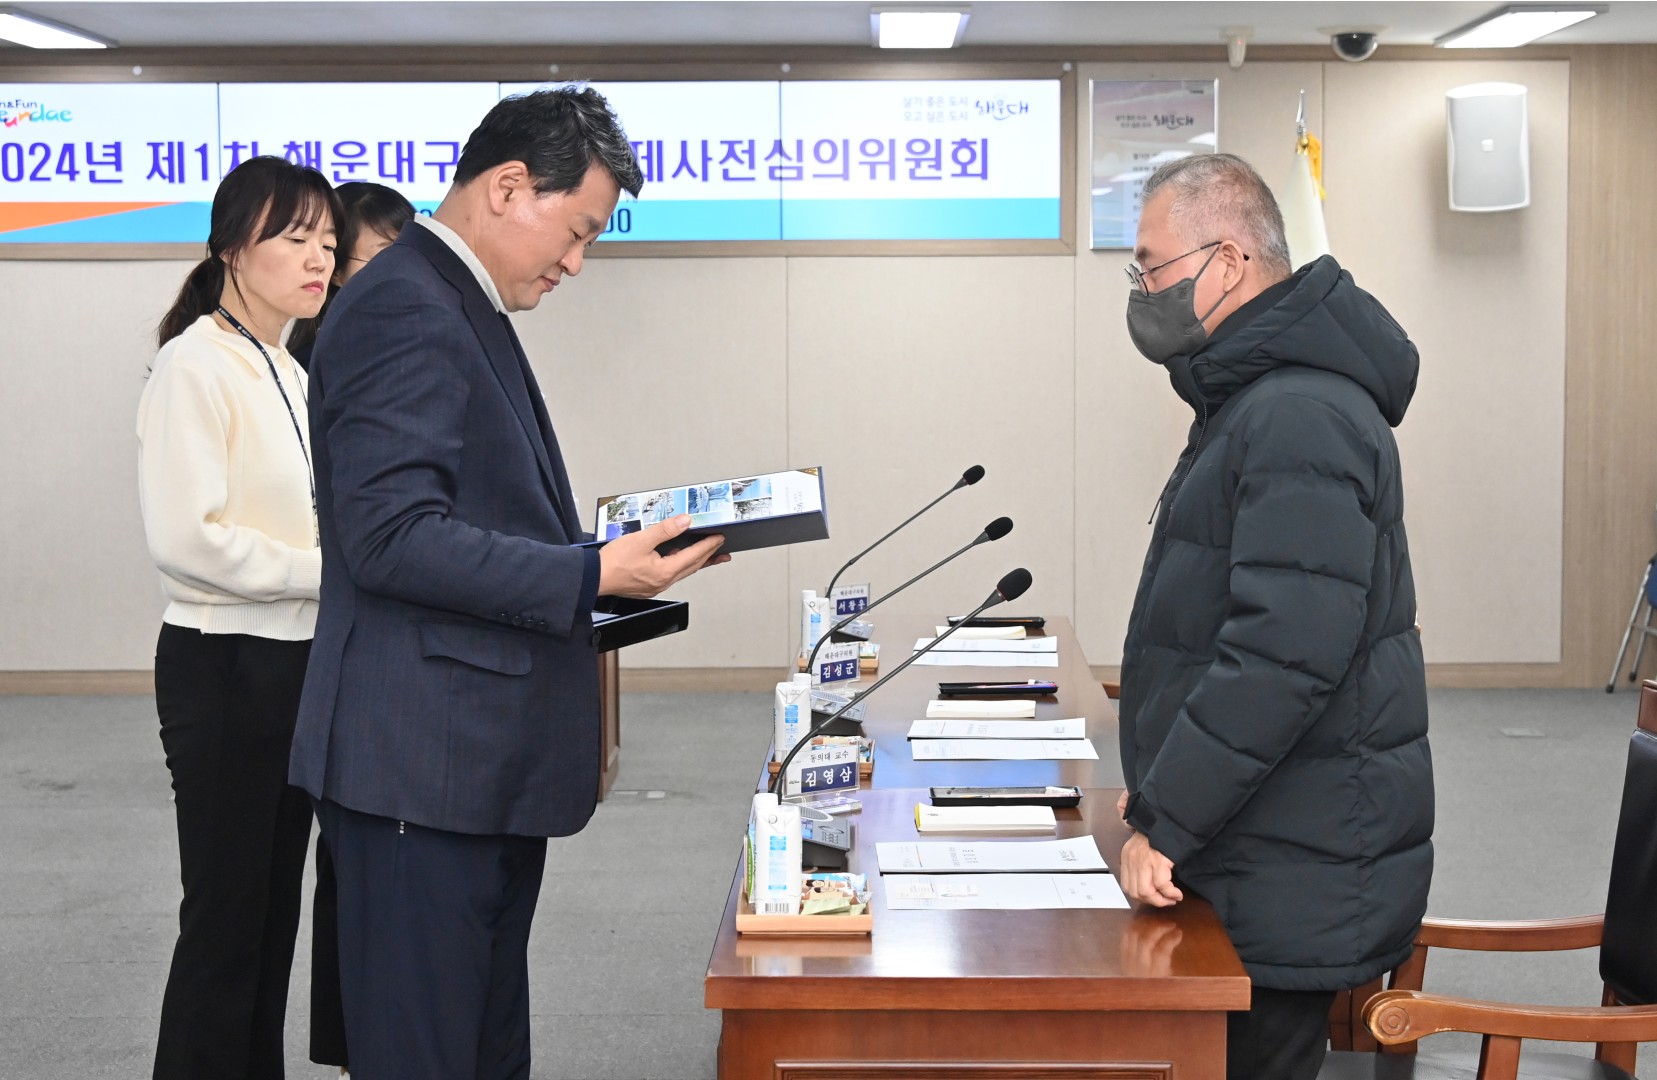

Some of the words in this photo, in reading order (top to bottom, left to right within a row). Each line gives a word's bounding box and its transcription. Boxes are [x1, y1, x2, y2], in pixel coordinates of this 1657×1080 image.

[949, 96, 968, 107] 도시
[949, 111, 968, 121] 도시
[810, 752, 831, 763] 동의대
[835, 750, 849, 760] 교수
[805, 766, 853, 787] 김영삼
